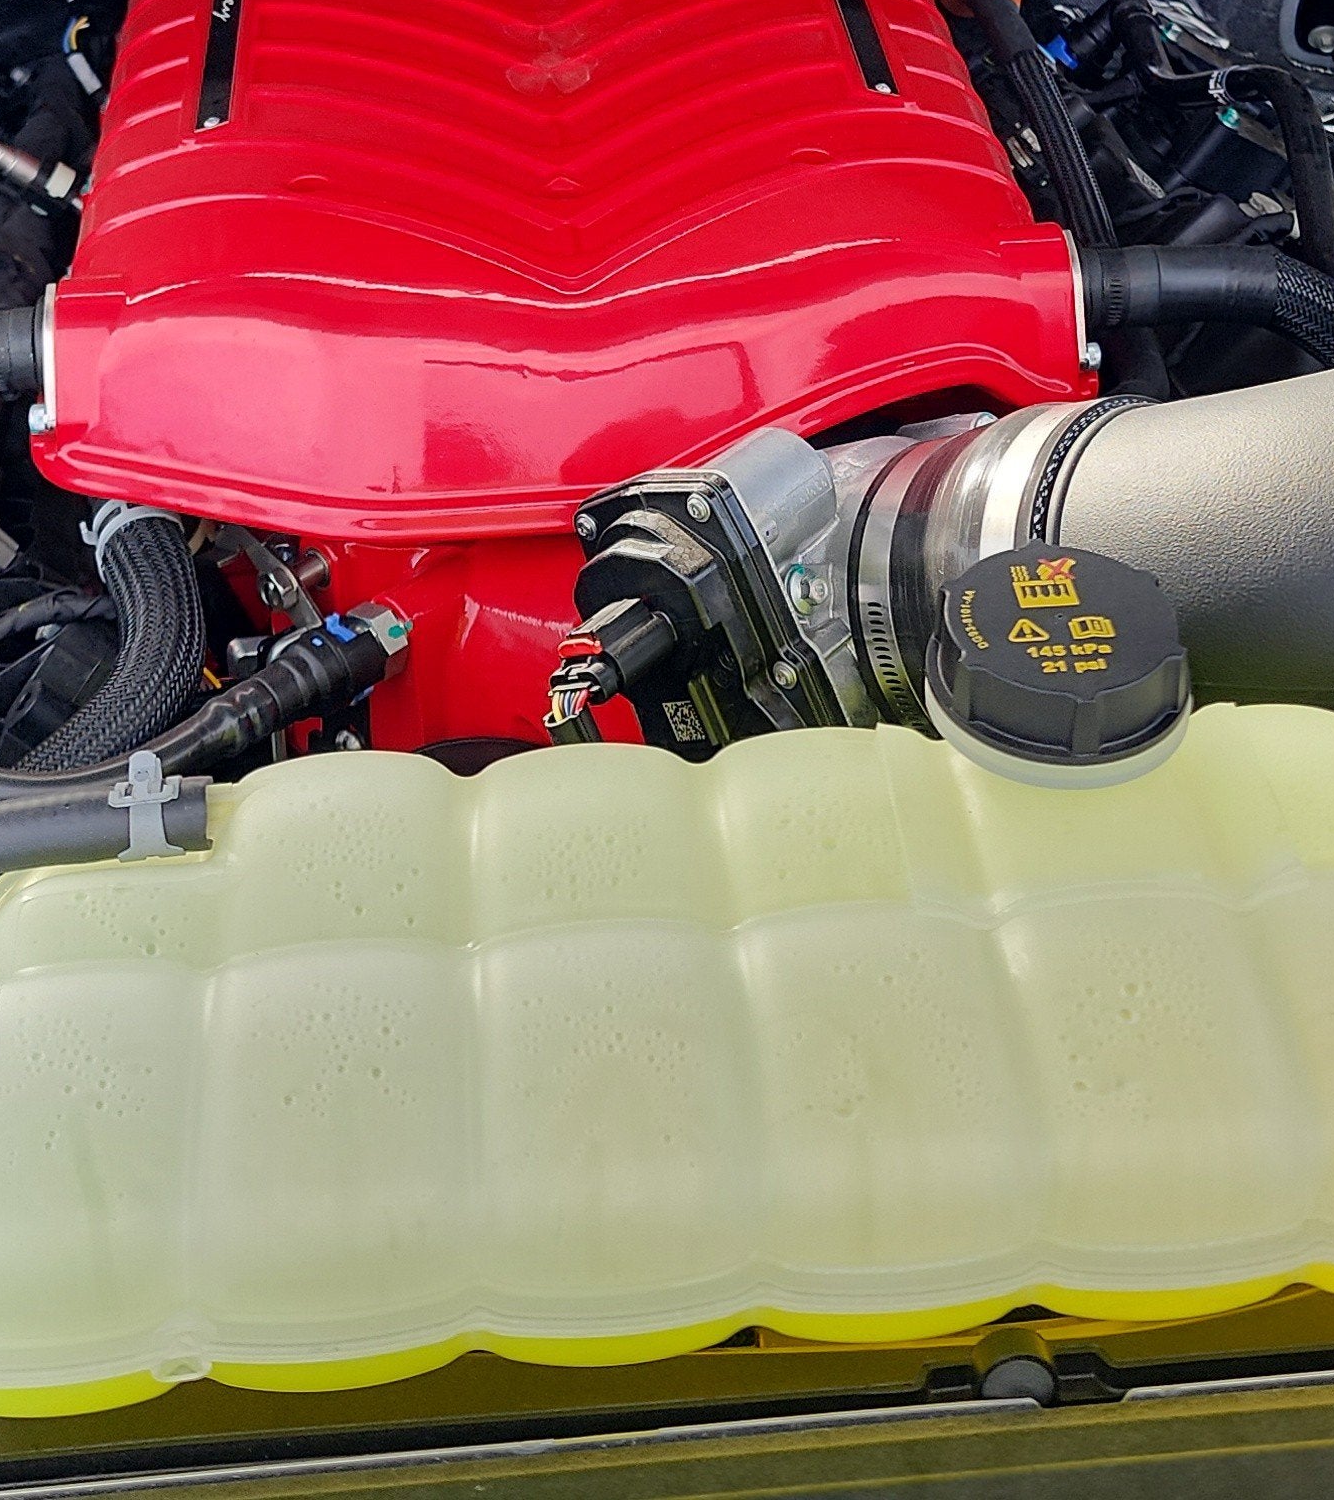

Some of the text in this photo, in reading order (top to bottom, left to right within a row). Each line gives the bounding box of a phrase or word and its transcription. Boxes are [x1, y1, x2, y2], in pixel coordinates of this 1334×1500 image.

[1025, 642, 1113, 658] 145 kPa
[1040, 657, 1108, 674] 21 psi
